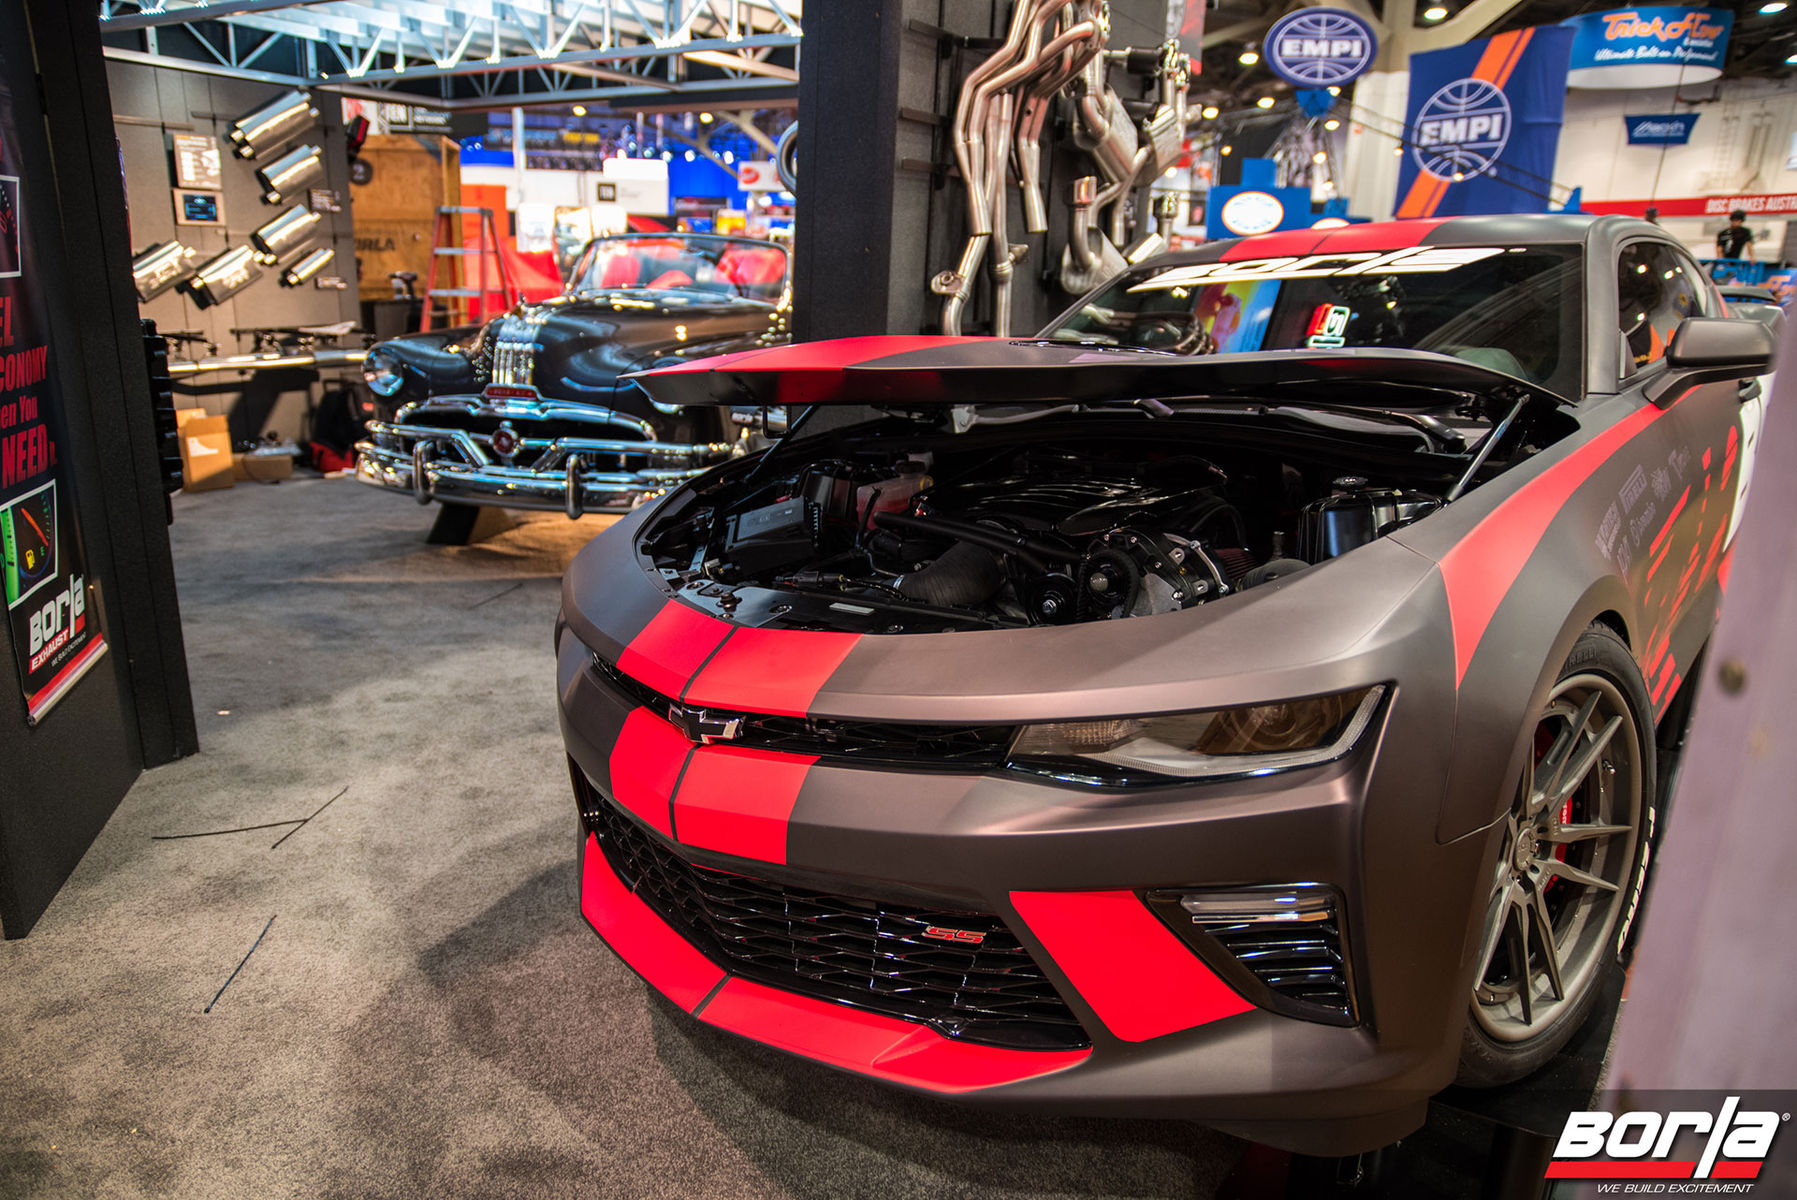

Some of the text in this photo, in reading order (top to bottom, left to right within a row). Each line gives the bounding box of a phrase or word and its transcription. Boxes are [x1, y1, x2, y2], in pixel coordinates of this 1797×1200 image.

[1602, 11, 1668, 42] Trick
[1280, 38, 1363, 58] EMPI
[1419, 113, 1504, 147] EMPI
[1705, 199, 1728, 214] DISC
[19, 396, 38, 424] You
[31, 628, 70, 671] EXHAUST
[921, 926, 986, 944] SS
